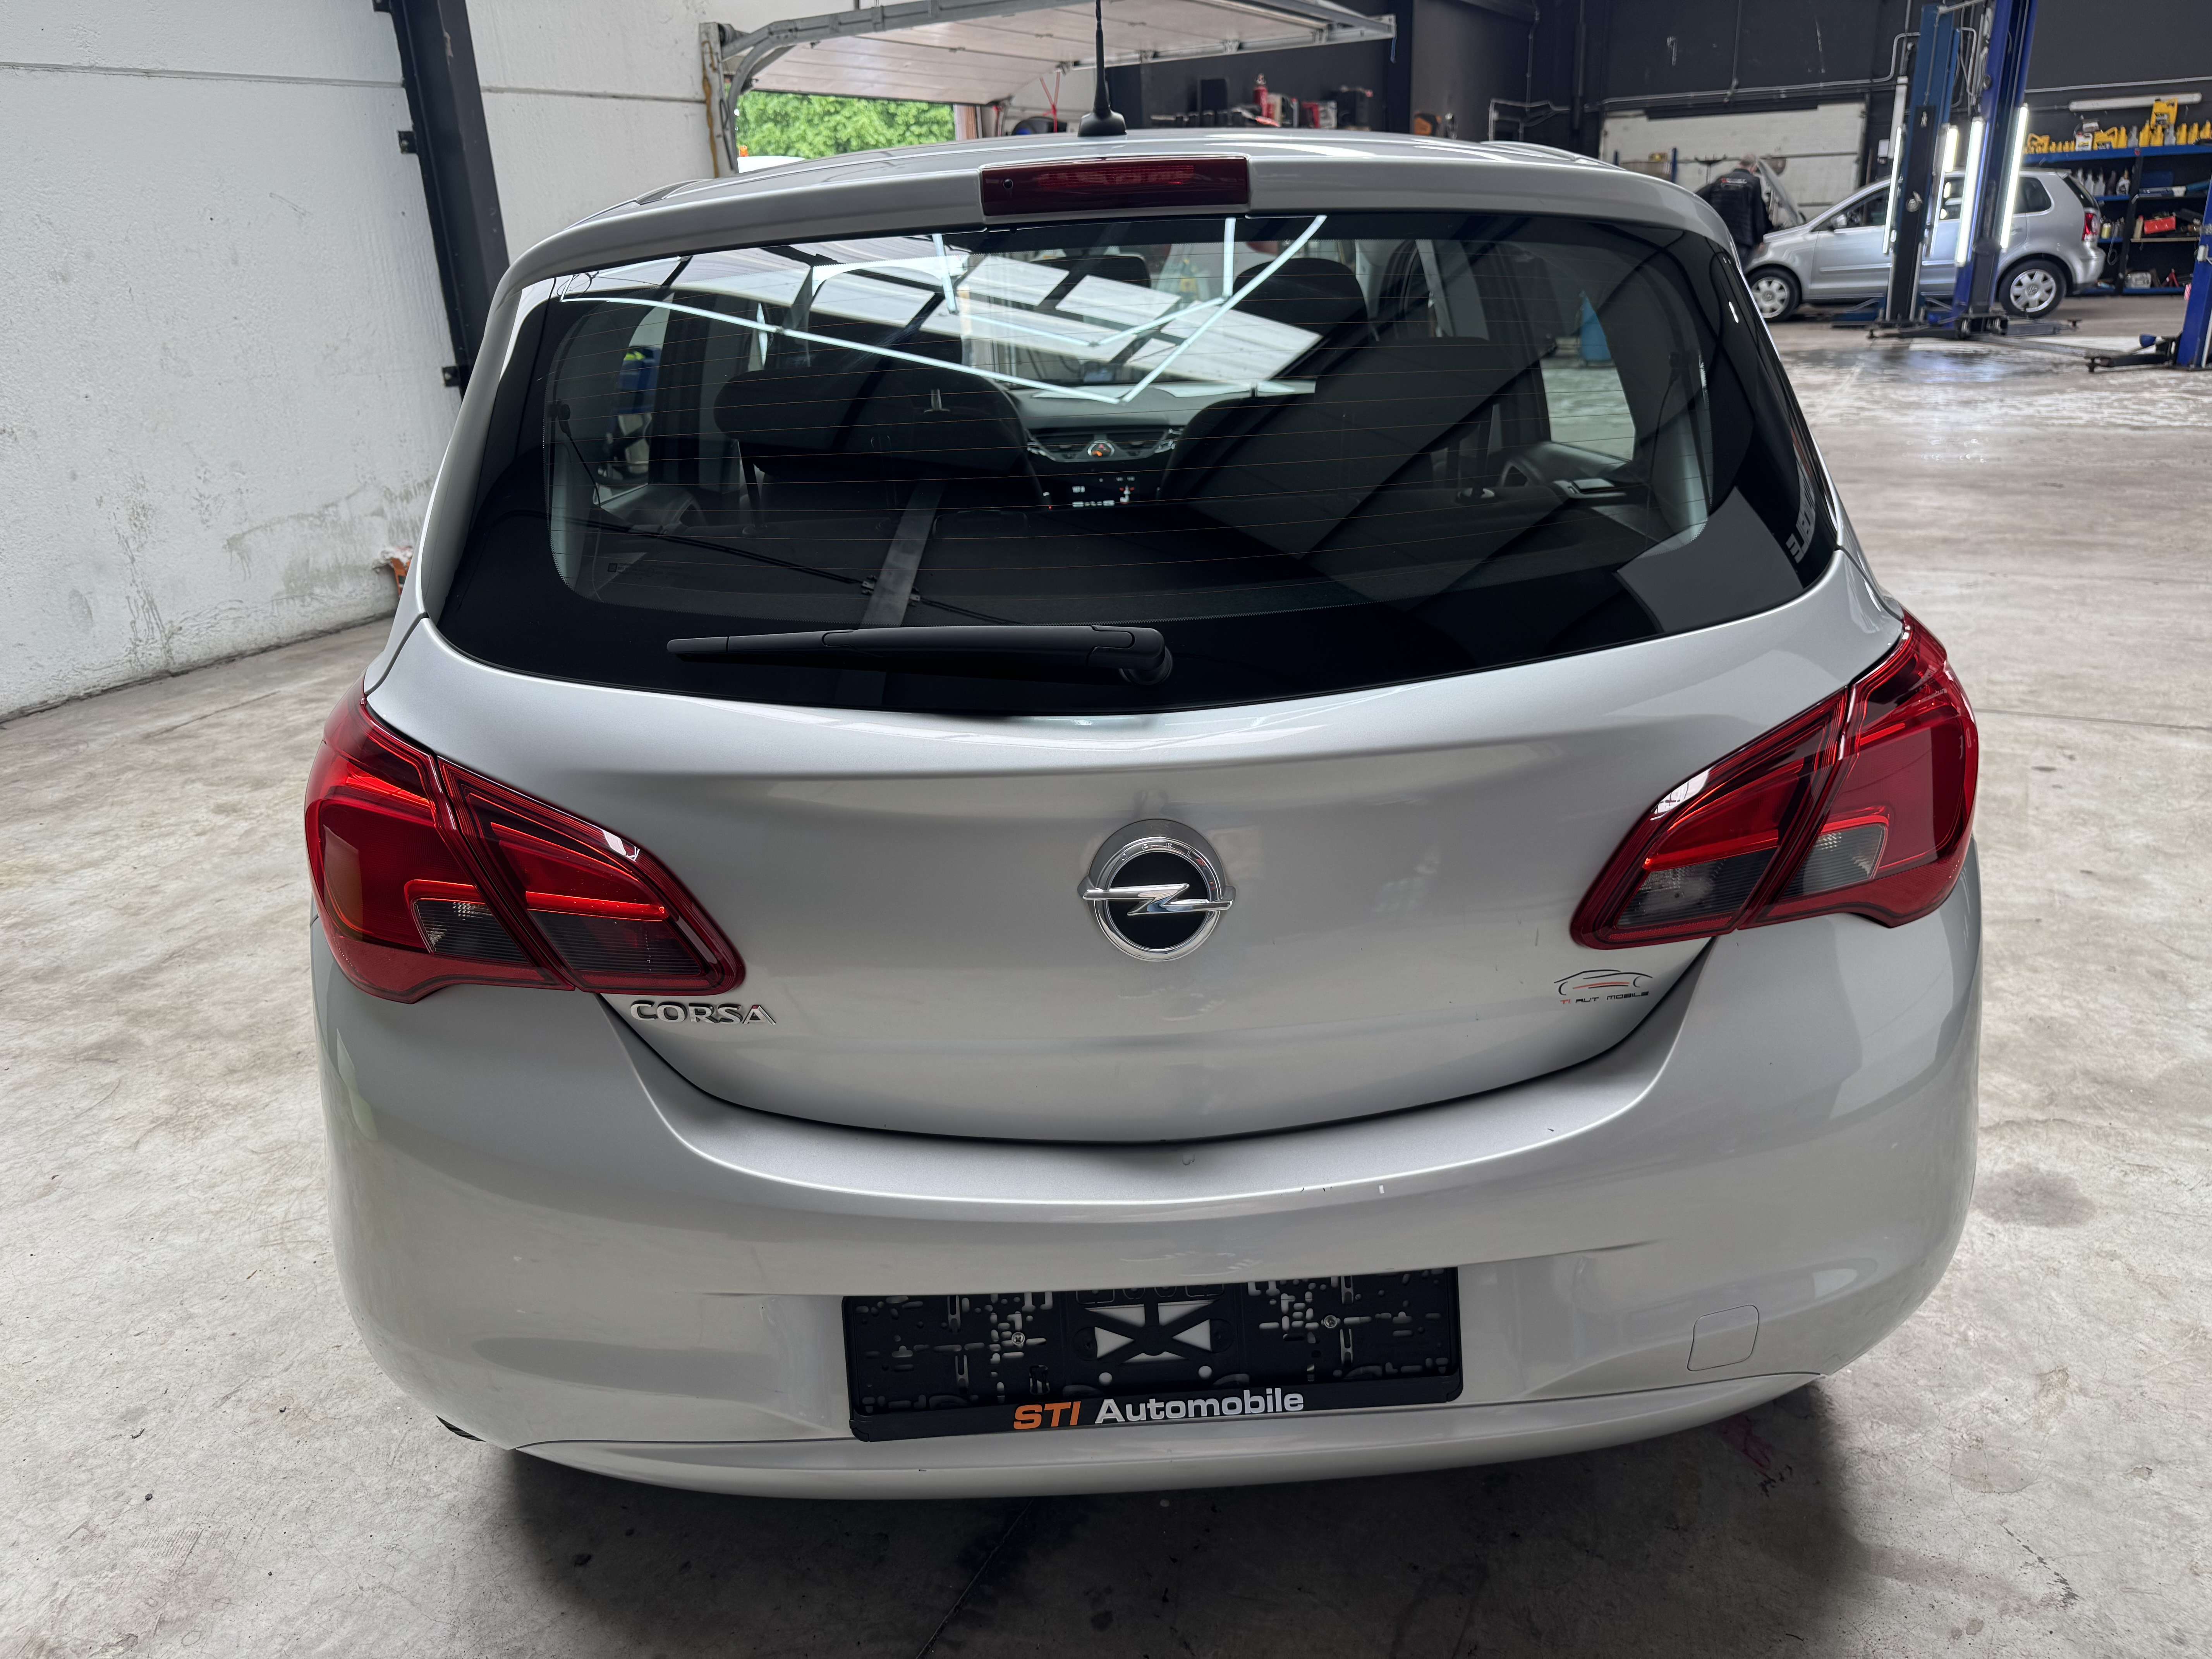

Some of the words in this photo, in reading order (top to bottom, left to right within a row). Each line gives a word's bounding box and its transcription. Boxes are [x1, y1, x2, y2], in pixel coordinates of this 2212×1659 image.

[630, 1000, 776, 1025] CORSA
[1013, 1401, 1081, 1429] STI
[1095, 1388, 1304, 1424] Automobile
